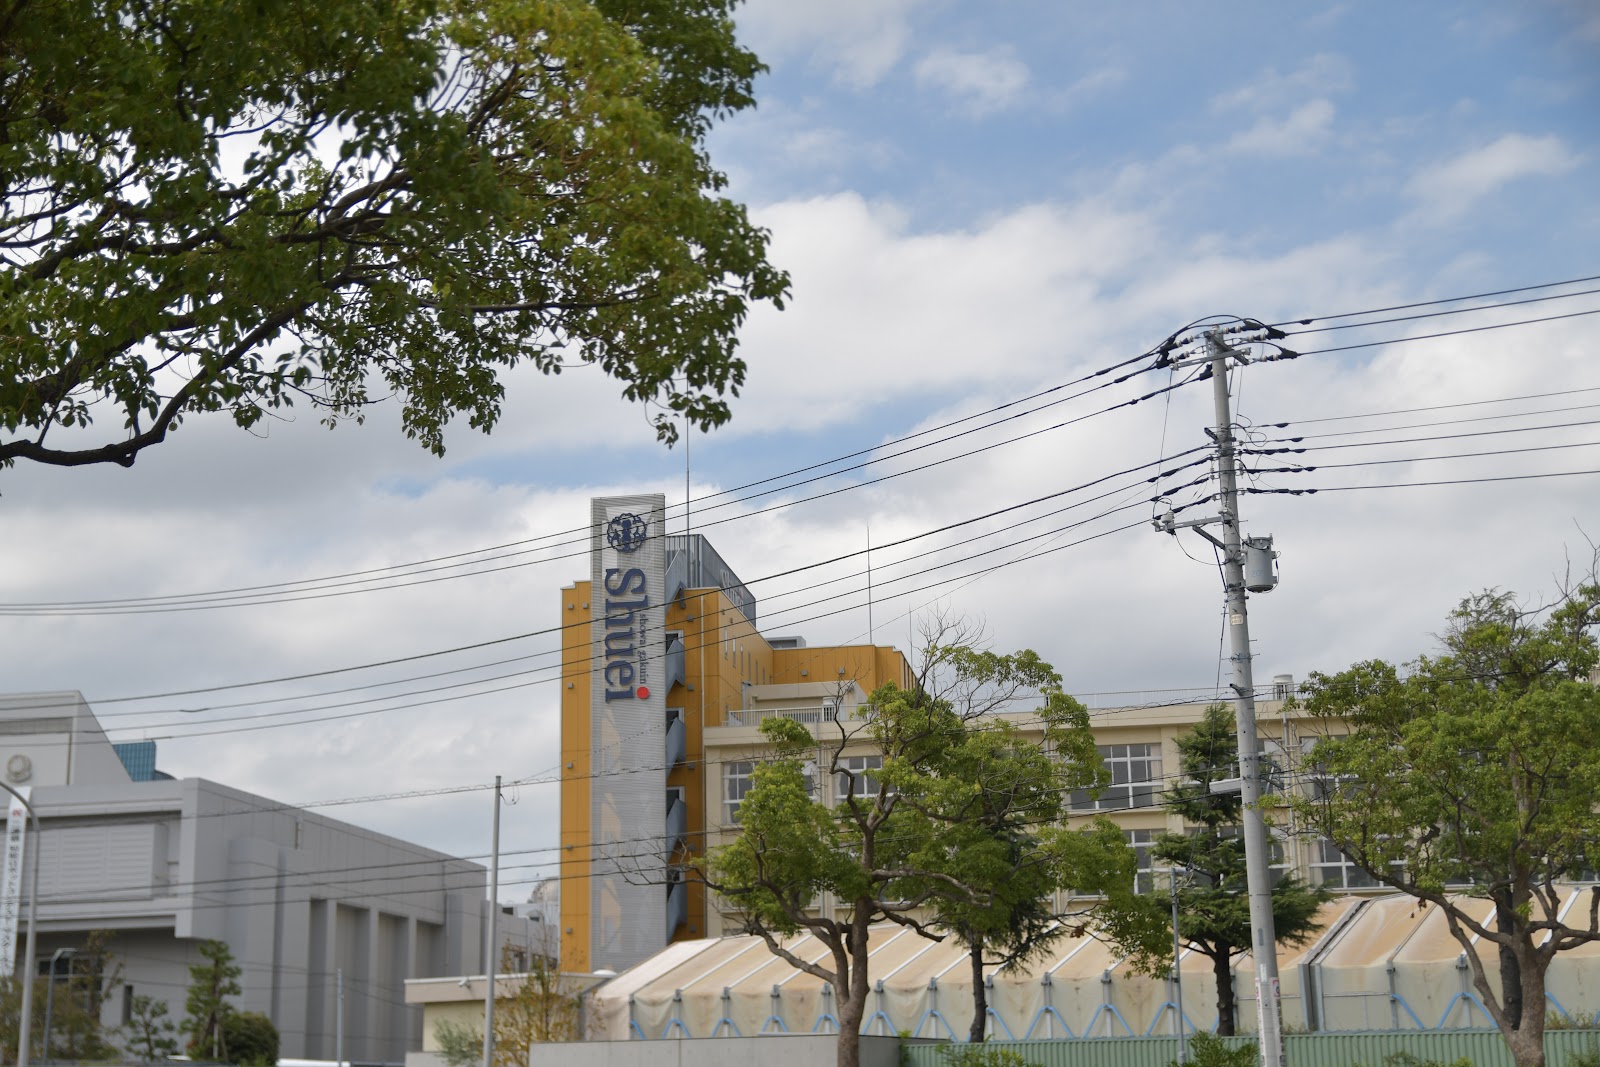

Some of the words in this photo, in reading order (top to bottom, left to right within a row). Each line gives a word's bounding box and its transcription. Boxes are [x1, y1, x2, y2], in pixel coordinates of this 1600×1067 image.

[604, 568, 649, 704] Shuei
[638, 614, 648, 645] showa
[636, 650, 648, 684] gakuin
